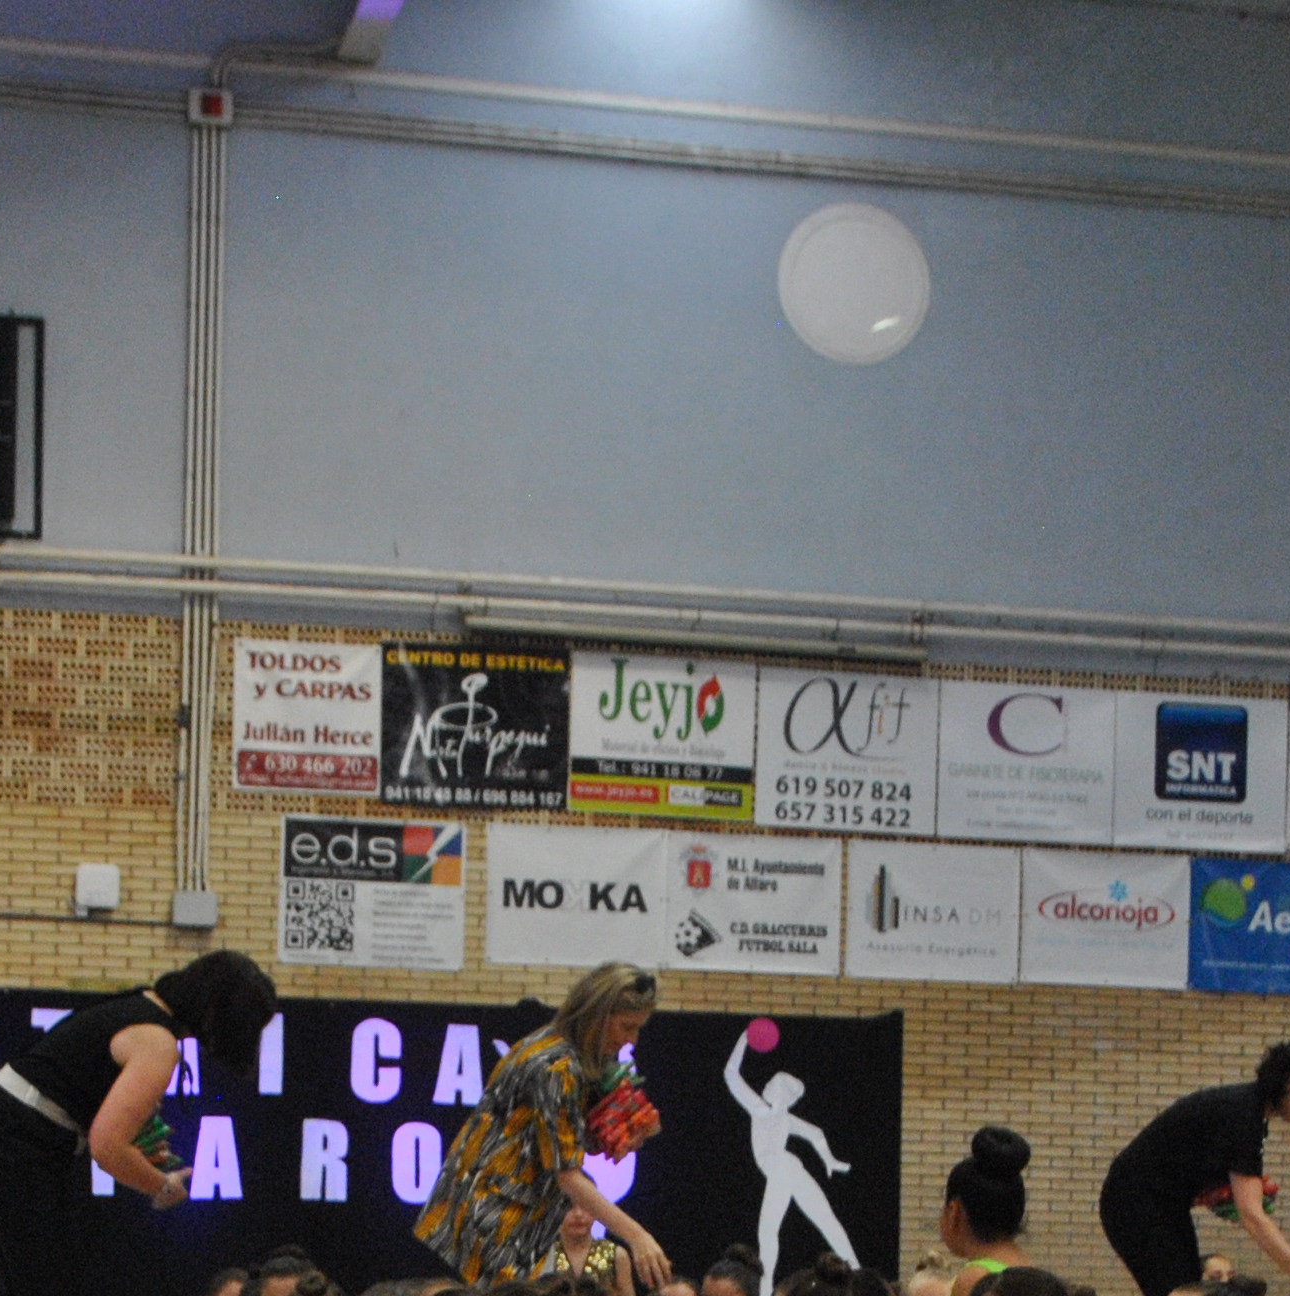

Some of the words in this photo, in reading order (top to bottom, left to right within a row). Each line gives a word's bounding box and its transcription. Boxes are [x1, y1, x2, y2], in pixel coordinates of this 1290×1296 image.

[247, 651, 342, 674] TOLDOS
[386, 650, 456, 666] CENTRO
[460, 653, 481, 668] DE
[254, 682, 266, 699] y
[275, 678, 372, 701] CARPAS
[599, 657, 725, 741] Jeyjo
[314, 724, 373, 746] Herce
[265, 753, 297, 774] 630
[303, 756, 336, 776] 466
[340, 757, 373, 777] 202
[1166, 749, 1237, 785] SNT
[385, 786, 410, 801] 941
[776, 775, 817, 797] 619
[823, 777, 864, 799] 507
[871, 780, 911, 802] 824
[774, 801, 816, 823] 657
[823, 804, 864, 826] 315
[870, 806, 911, 828] 422
[1145, 806, 1173, 821] con
[1178, 807, 1192, 822] el
[1195, 808, 1254, 827] deporte
[291, 827, 398, 870] e.d.s
[744, 876, 779, 892] Alfaro
